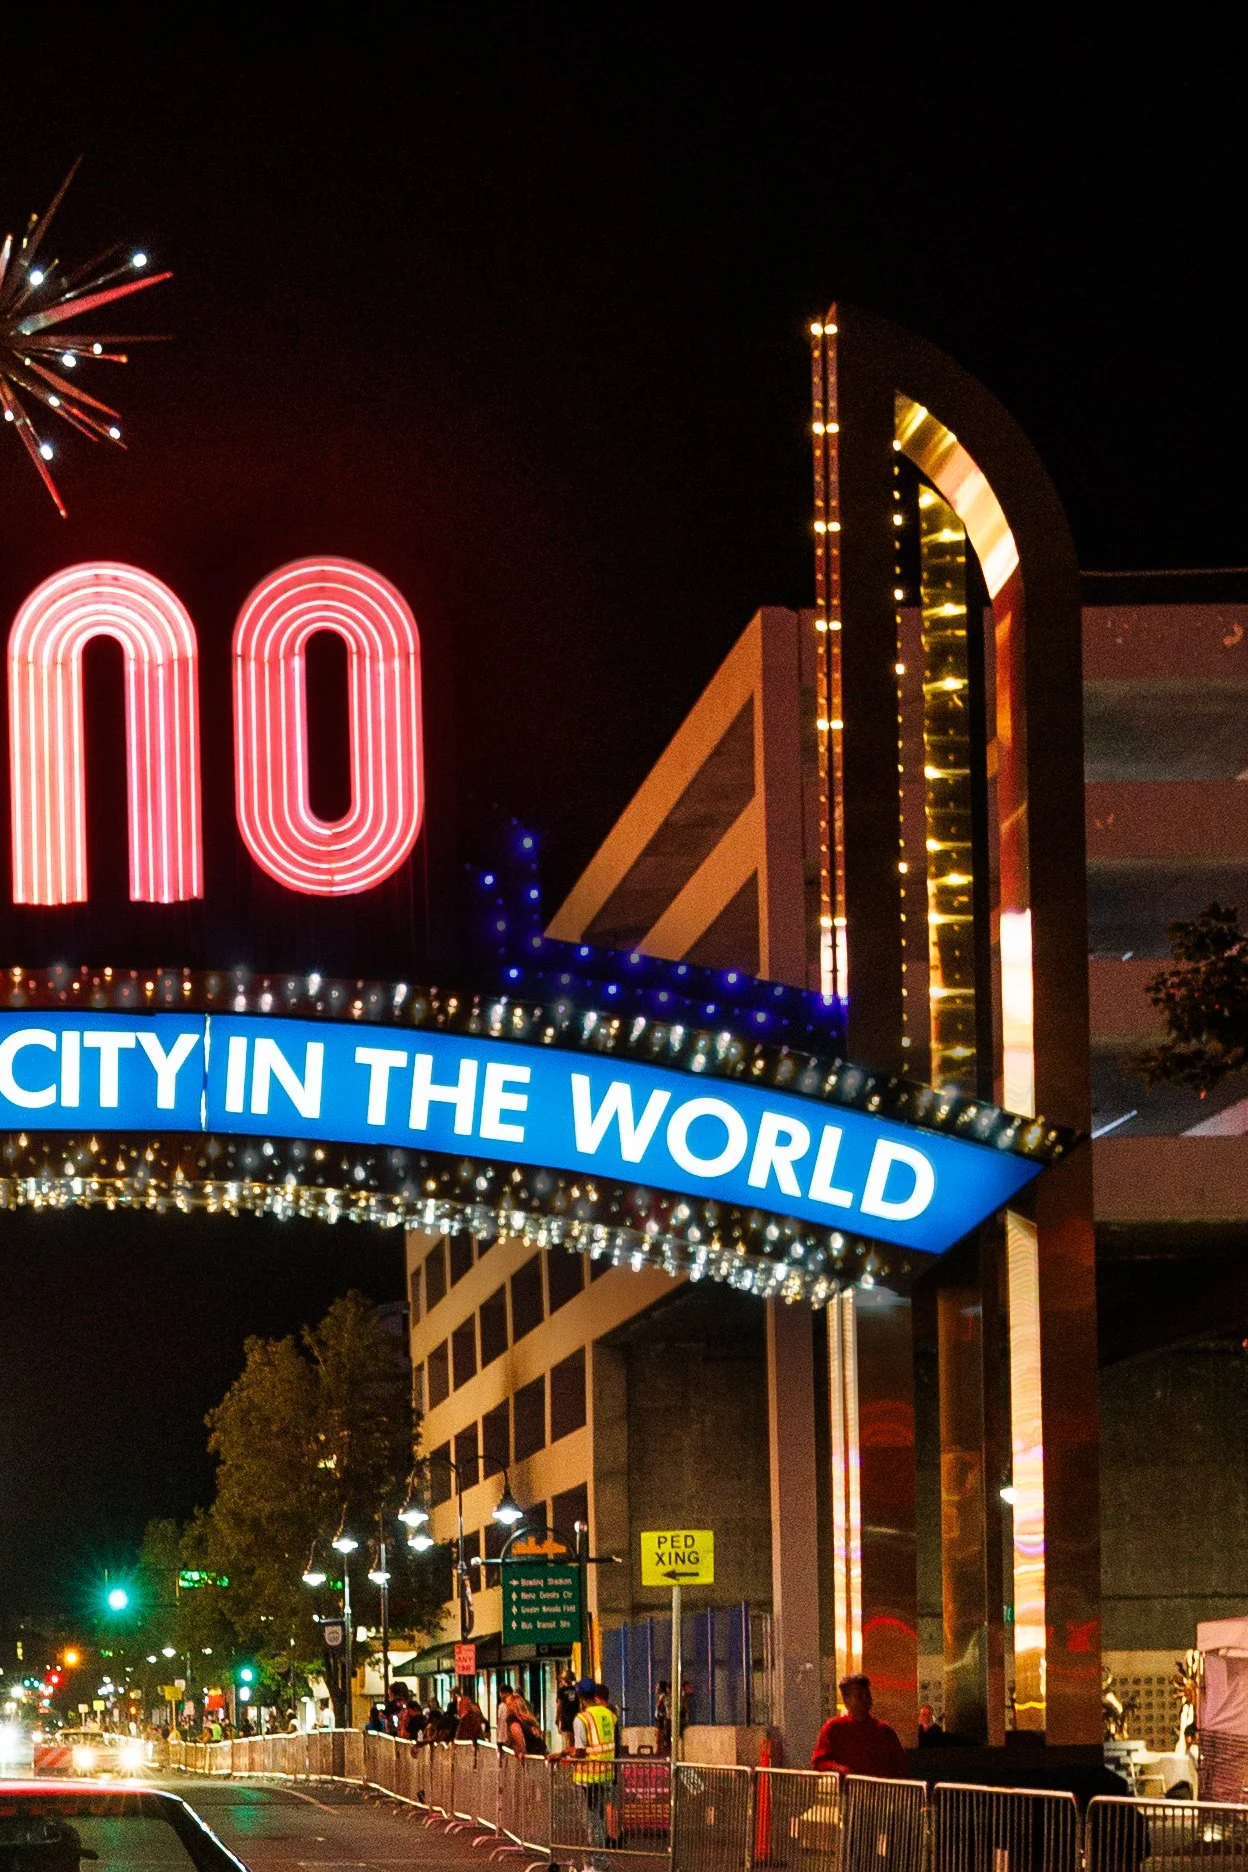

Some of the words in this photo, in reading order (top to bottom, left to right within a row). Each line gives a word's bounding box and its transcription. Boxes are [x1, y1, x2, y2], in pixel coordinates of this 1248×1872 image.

[225, 1036, 324, 1119] IN
[355, 1047, 531, 1142] THE
[571, 1073, 935, 1220] WORLD
[657, 1534, 695, 1549] PED
[655, 1550, 700, 1566] XING
